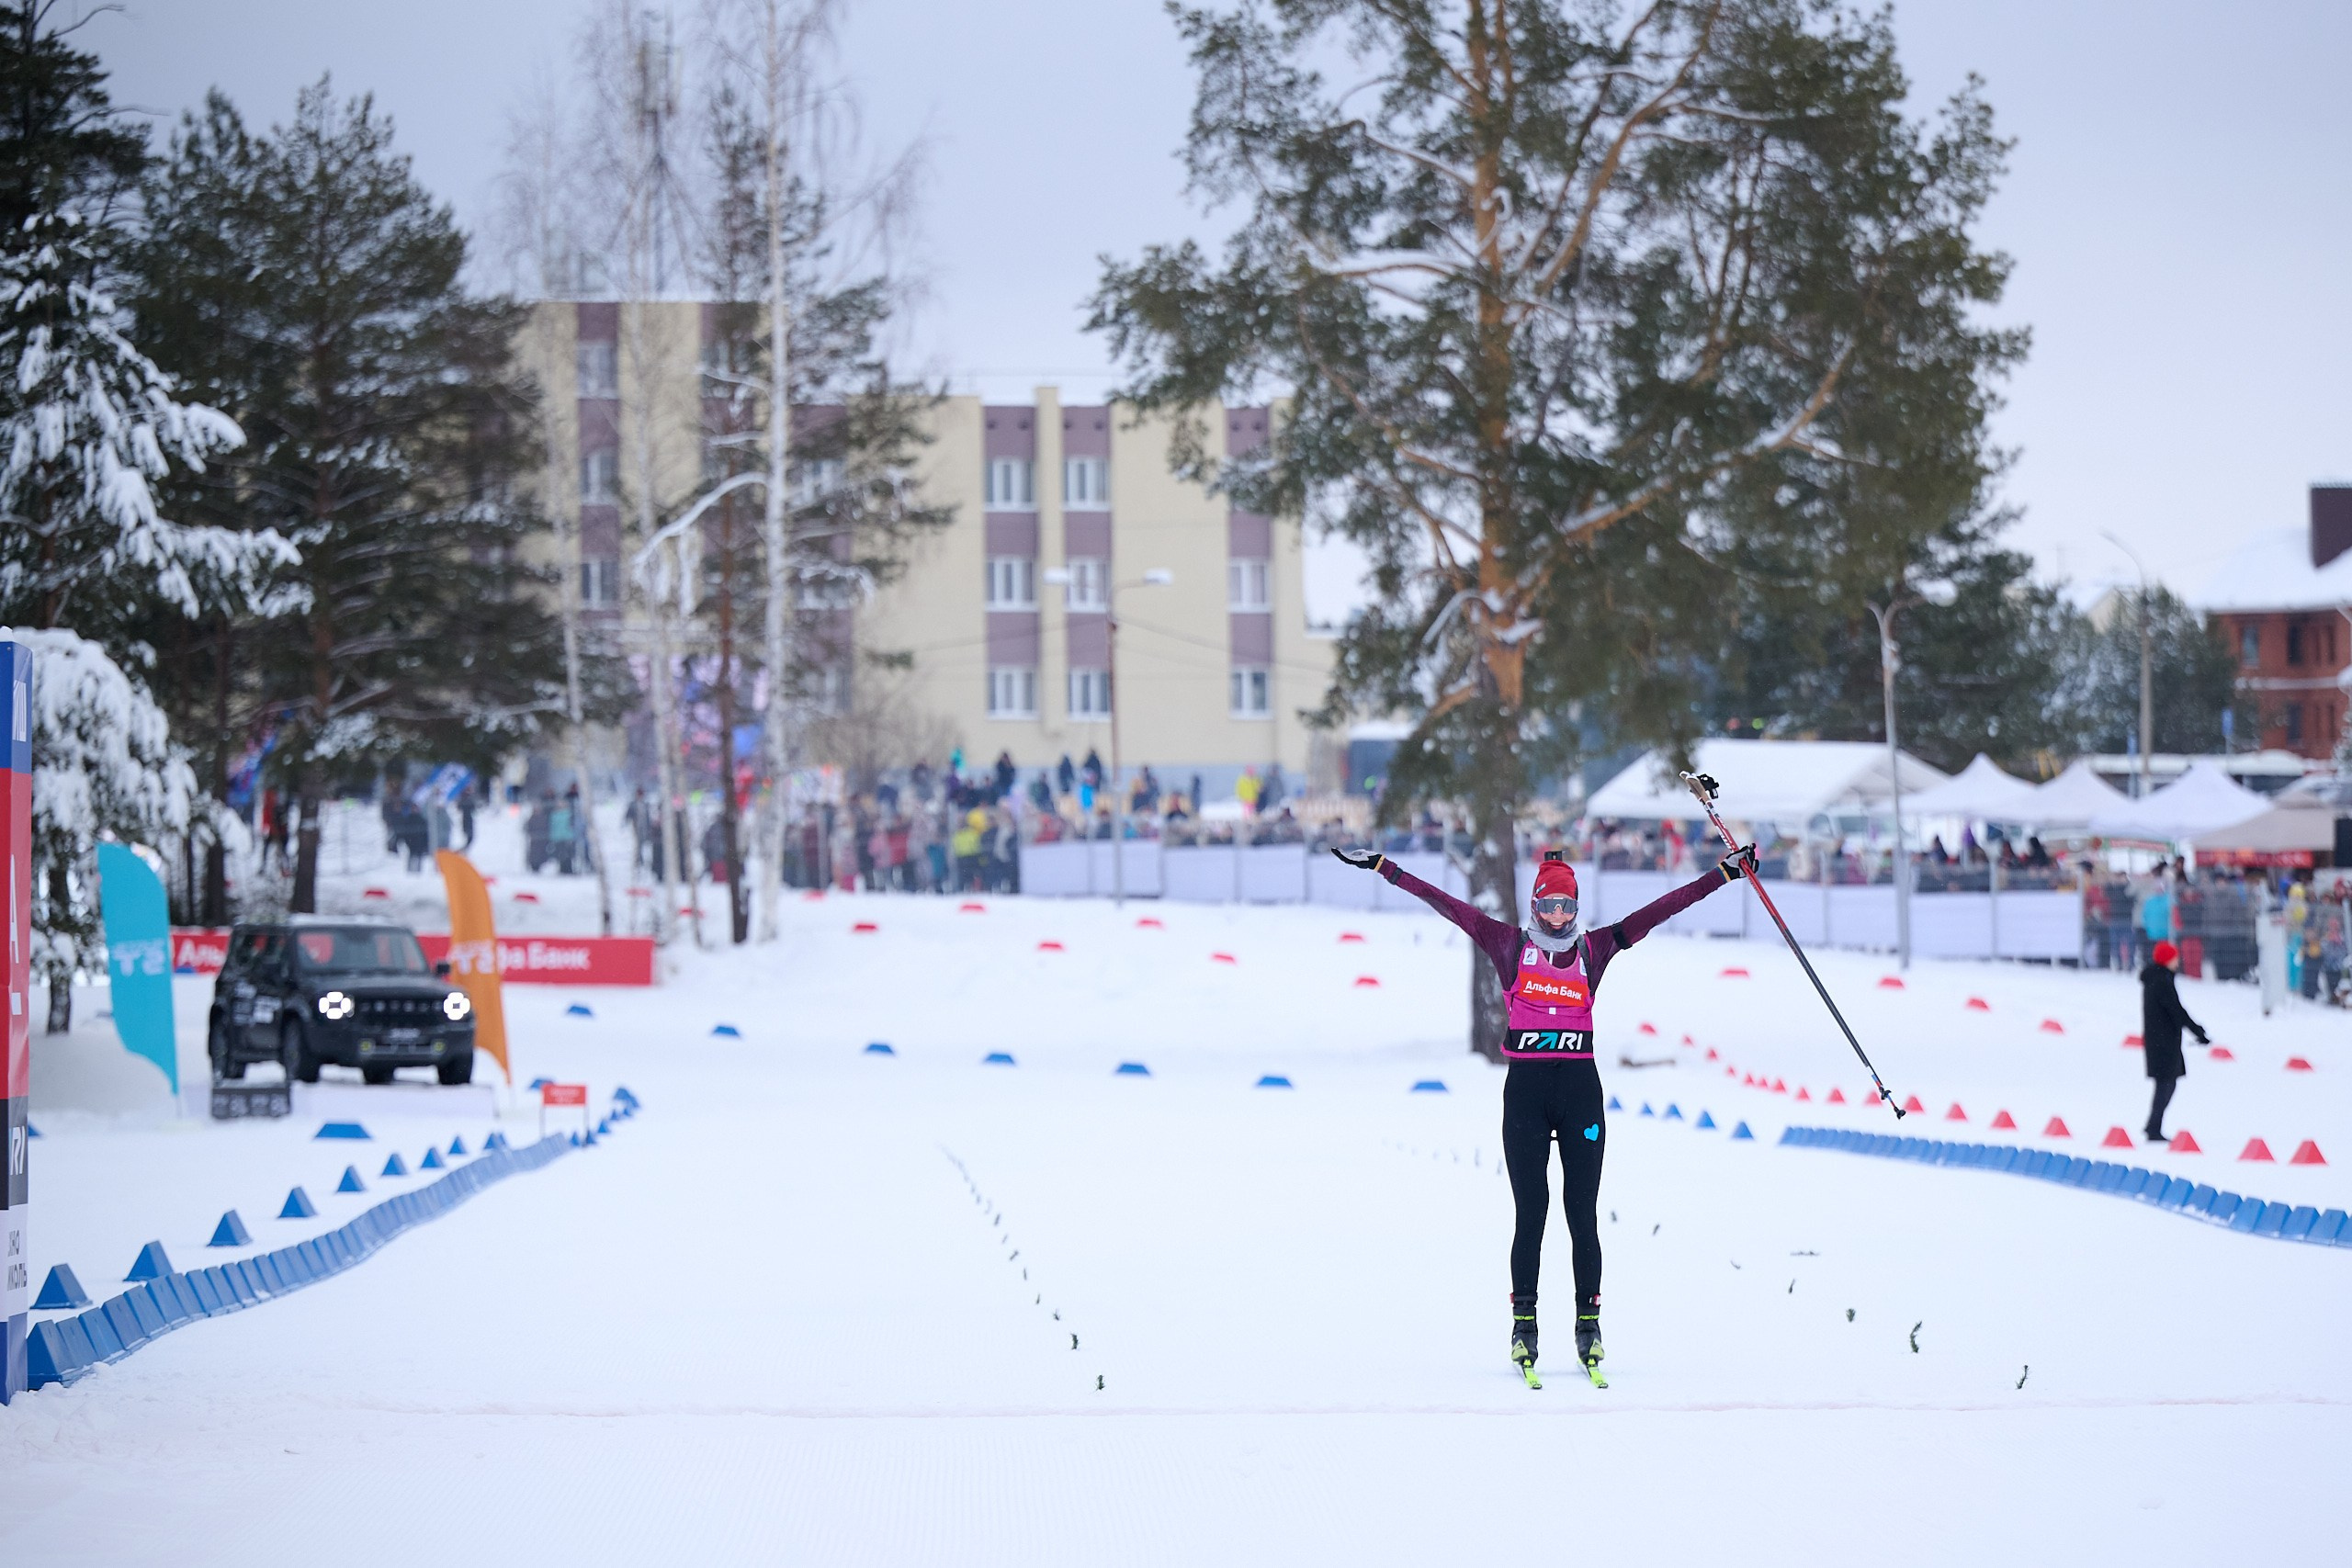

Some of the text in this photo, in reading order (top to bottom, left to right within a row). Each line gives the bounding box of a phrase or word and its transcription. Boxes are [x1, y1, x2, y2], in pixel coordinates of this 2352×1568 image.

[527, 942, 591, 970] Банк
[1525, 980, 1582, 1001] Альфа Банк
[1518, 1032, 1583, 1050] PARI
